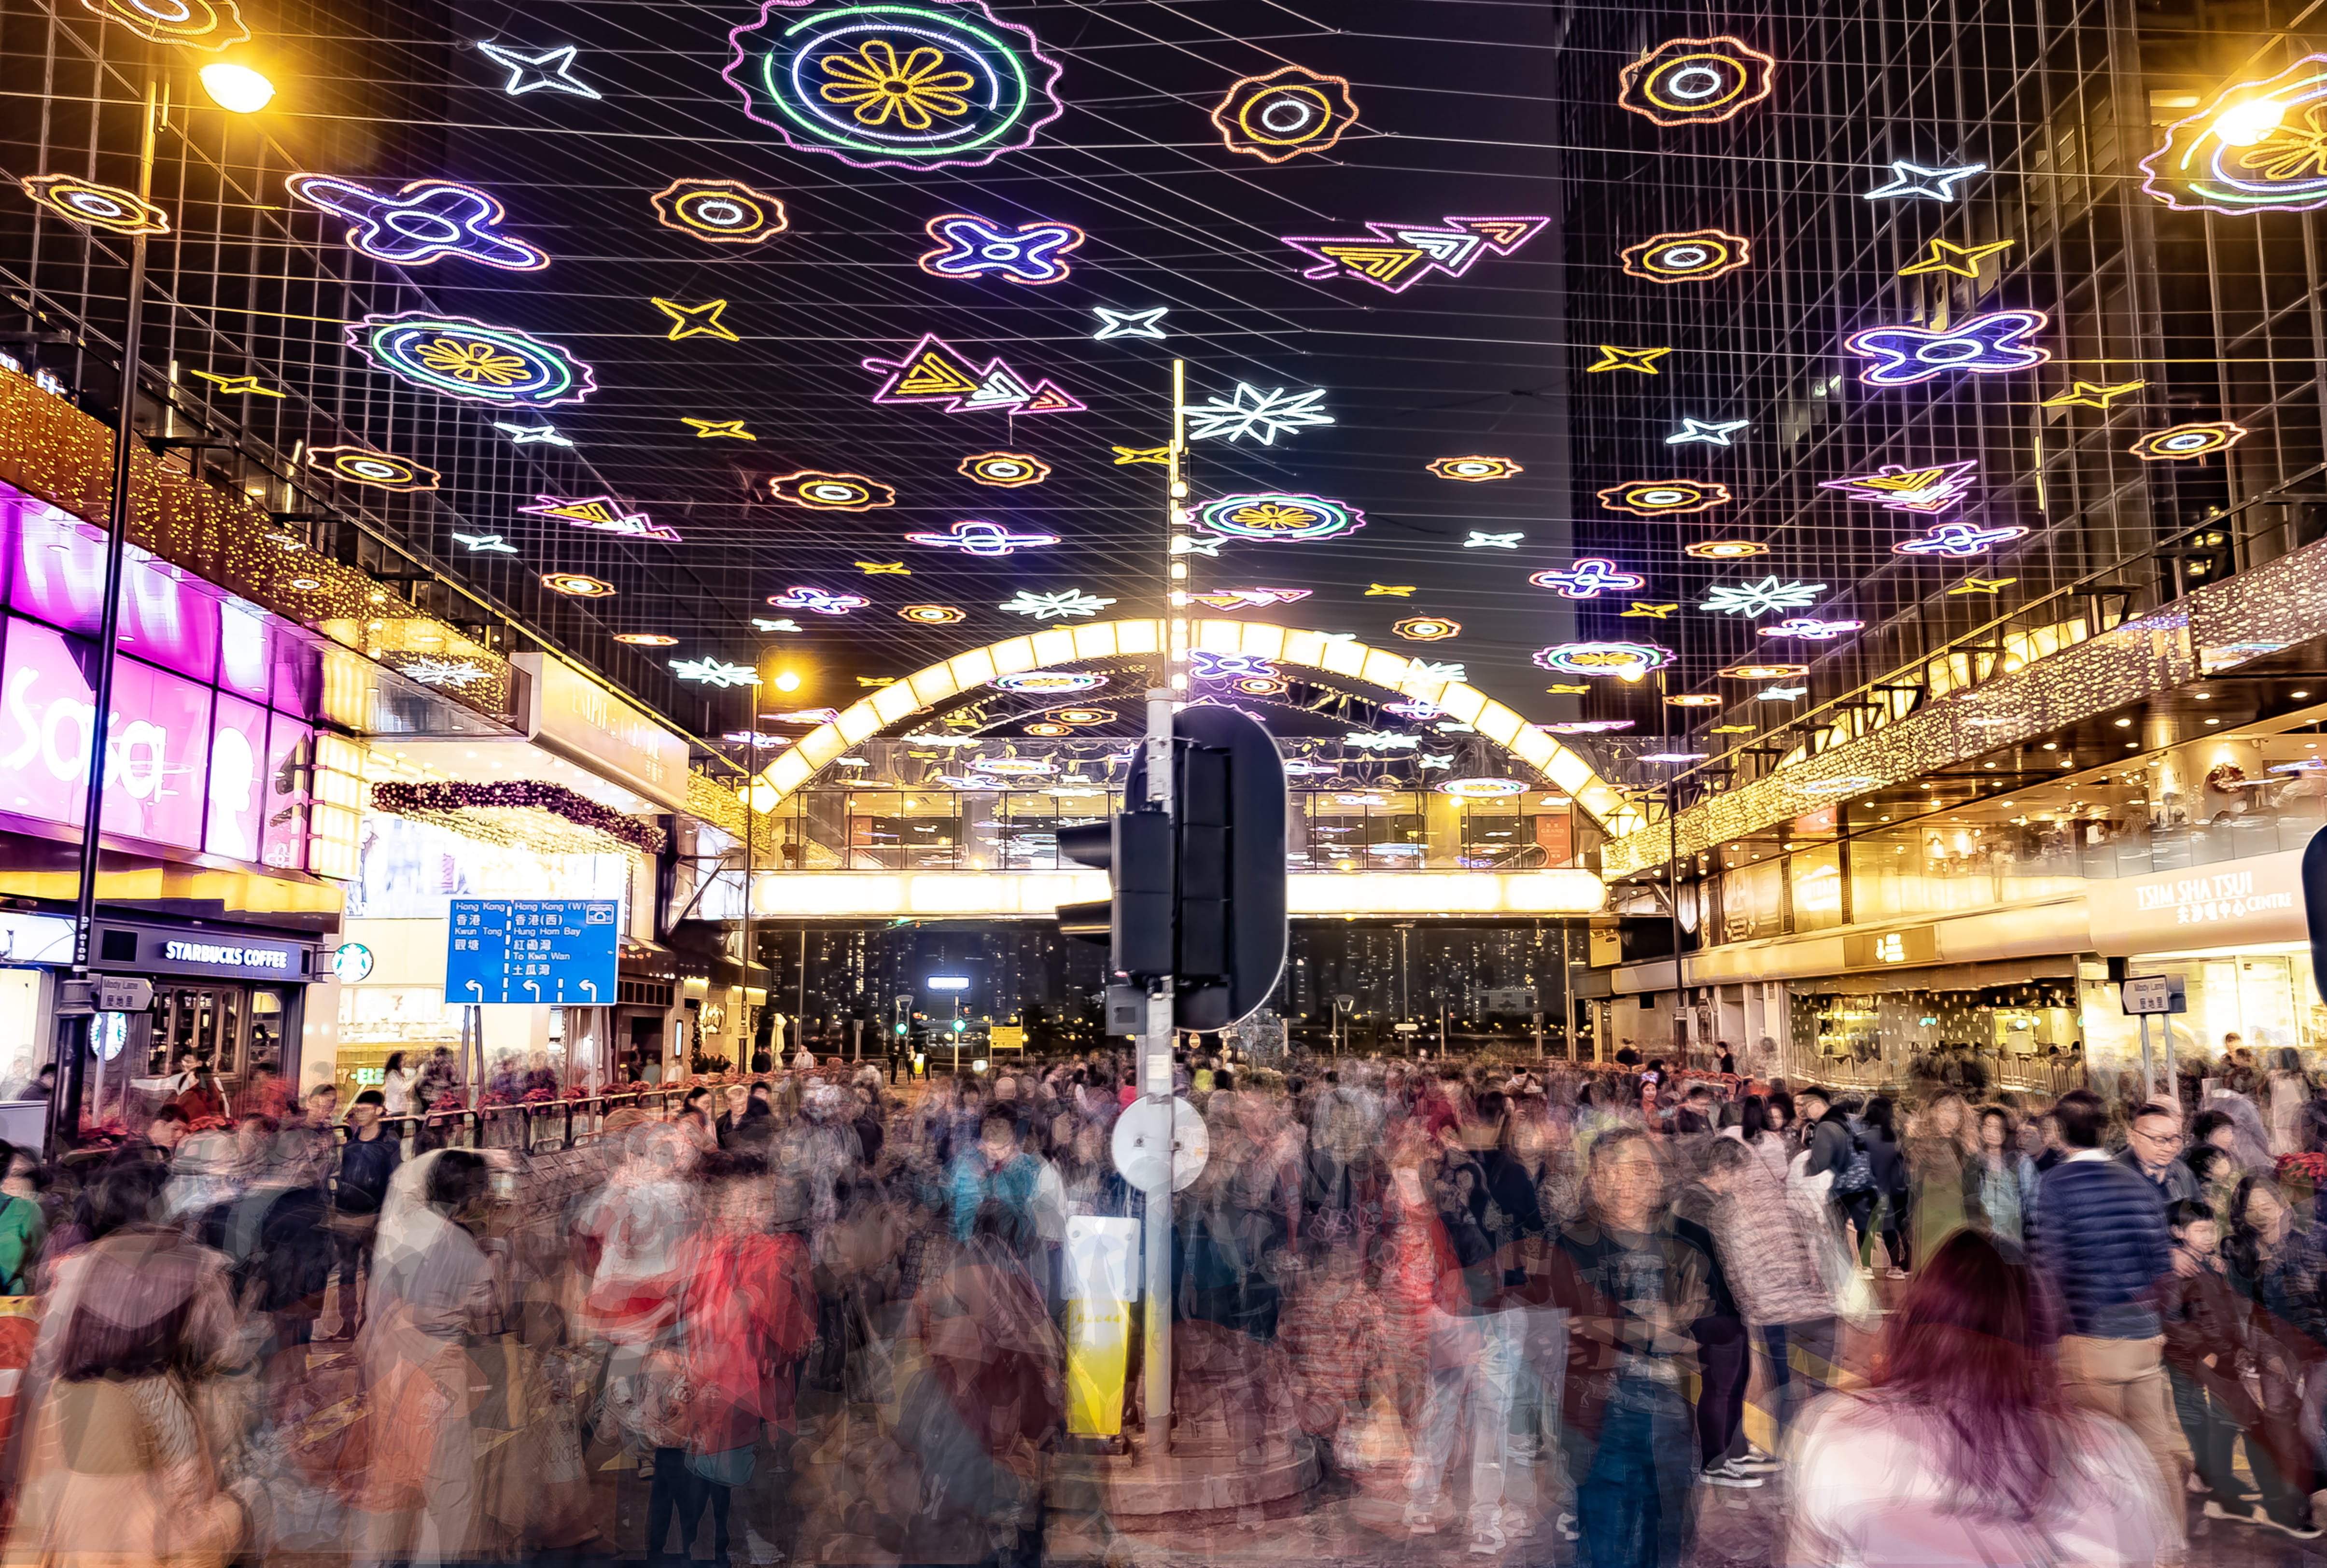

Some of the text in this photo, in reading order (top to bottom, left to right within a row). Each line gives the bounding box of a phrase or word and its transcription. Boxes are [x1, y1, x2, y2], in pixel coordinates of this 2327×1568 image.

[2135, 871, 2253, 908] TSIM SHA TSUI
[456, 902, 505, 912] Hong Kong
[514, 902, 587, 912] Hong Kong (W)
[2246, 892, 2293, 911] CENTRE
[2176, 899, 2246, 924] 尖沙咀中心
[80, 916, 90, 930] DF
[456, 914, 480, 925] 香港
[454, 926, 502, 937] Kwun Tong
[513, 927, 536, 937] Hung
[563, 927, 581, 937] Bay
[455, 938, 479, 951] 觀塘
[166, 940, 288, 969] STARBUCKS COFFEE
[513, 952, 571, 960] To Kwa Wan
[512, 964, 550, 976] 土瓜灣
[103, 979, 139, 990] Mody Lane
